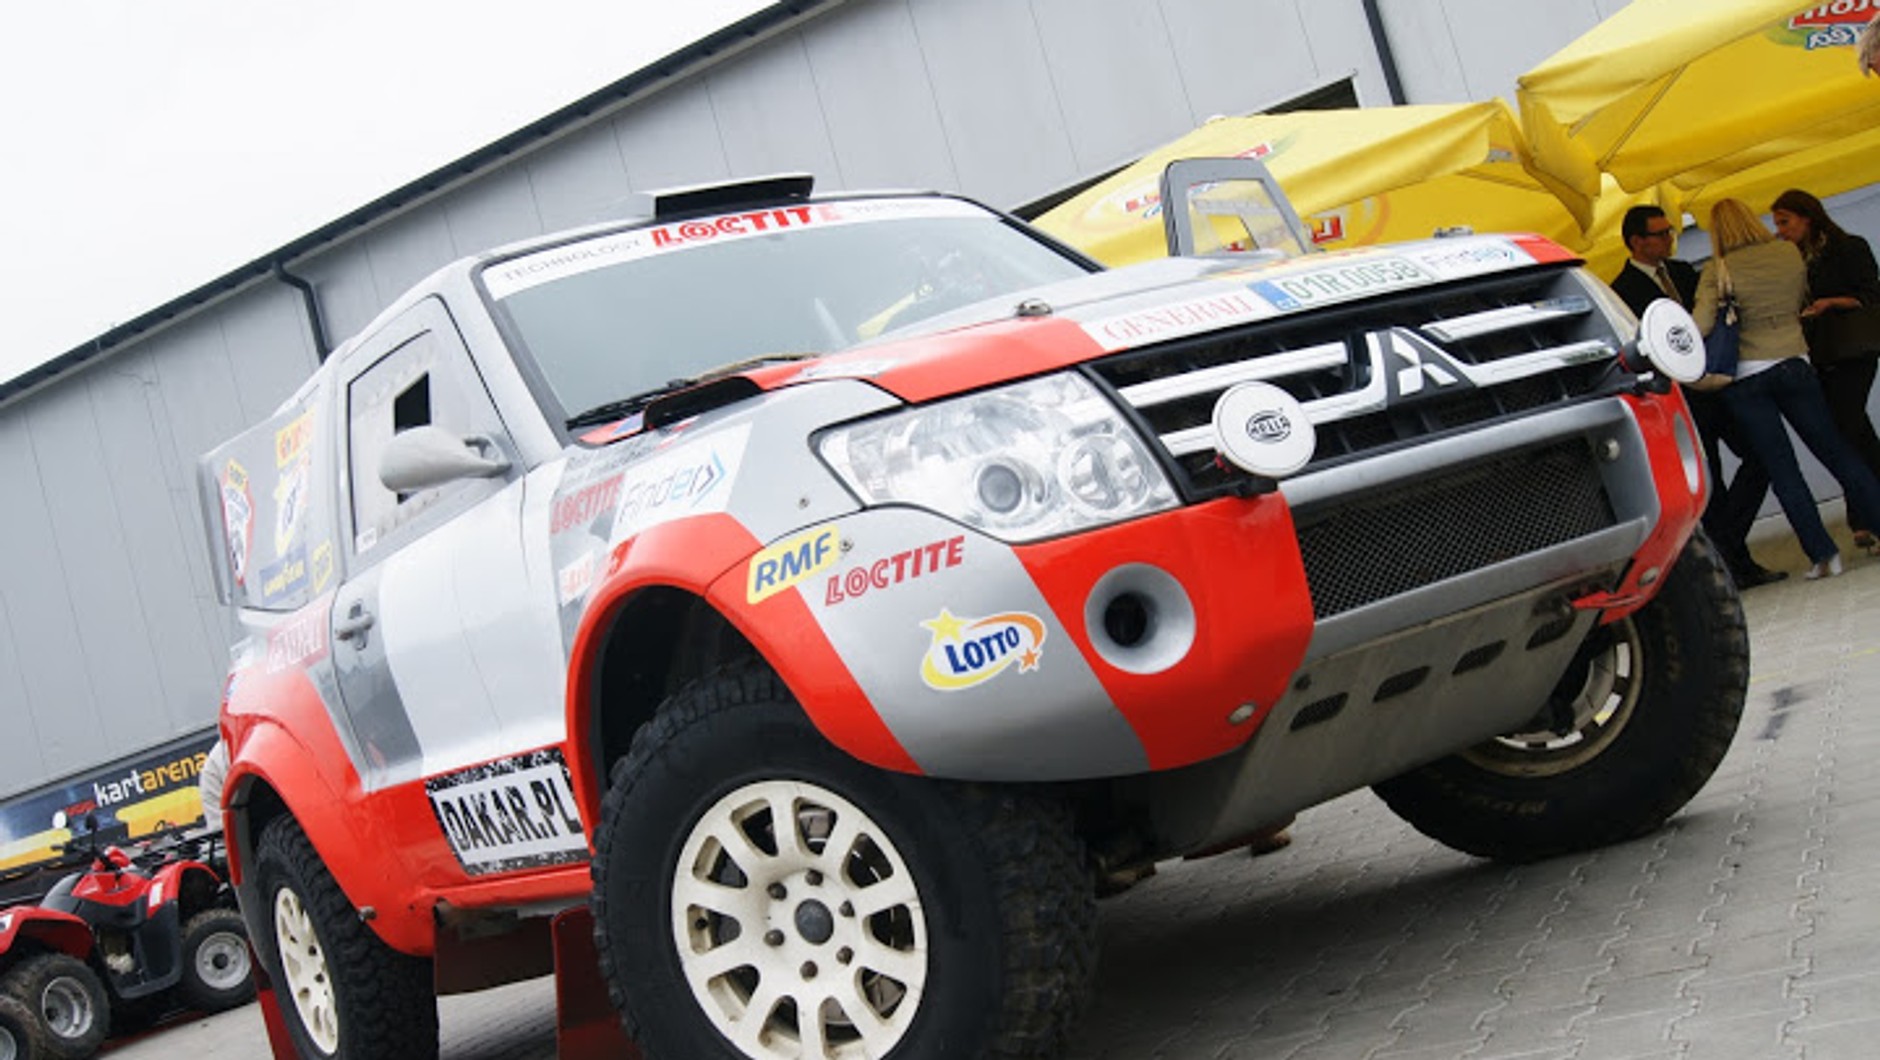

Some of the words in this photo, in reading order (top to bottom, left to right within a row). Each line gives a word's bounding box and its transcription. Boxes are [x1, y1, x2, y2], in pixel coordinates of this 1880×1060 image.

[650, 206, 843, 247] LOCTITE
[1104, 295, 1253, 342] GENERALI
[551, 473, 626, 535] LOCTITE
[755, 532, 832, 592] RMF
[825, 535, 966, 606] LOCTITE
[944, 626, 1020, 674] LOTTO
[94, 752, 208, 808] kartarena
[441, 777, 585, 852] DAKAR.PL
